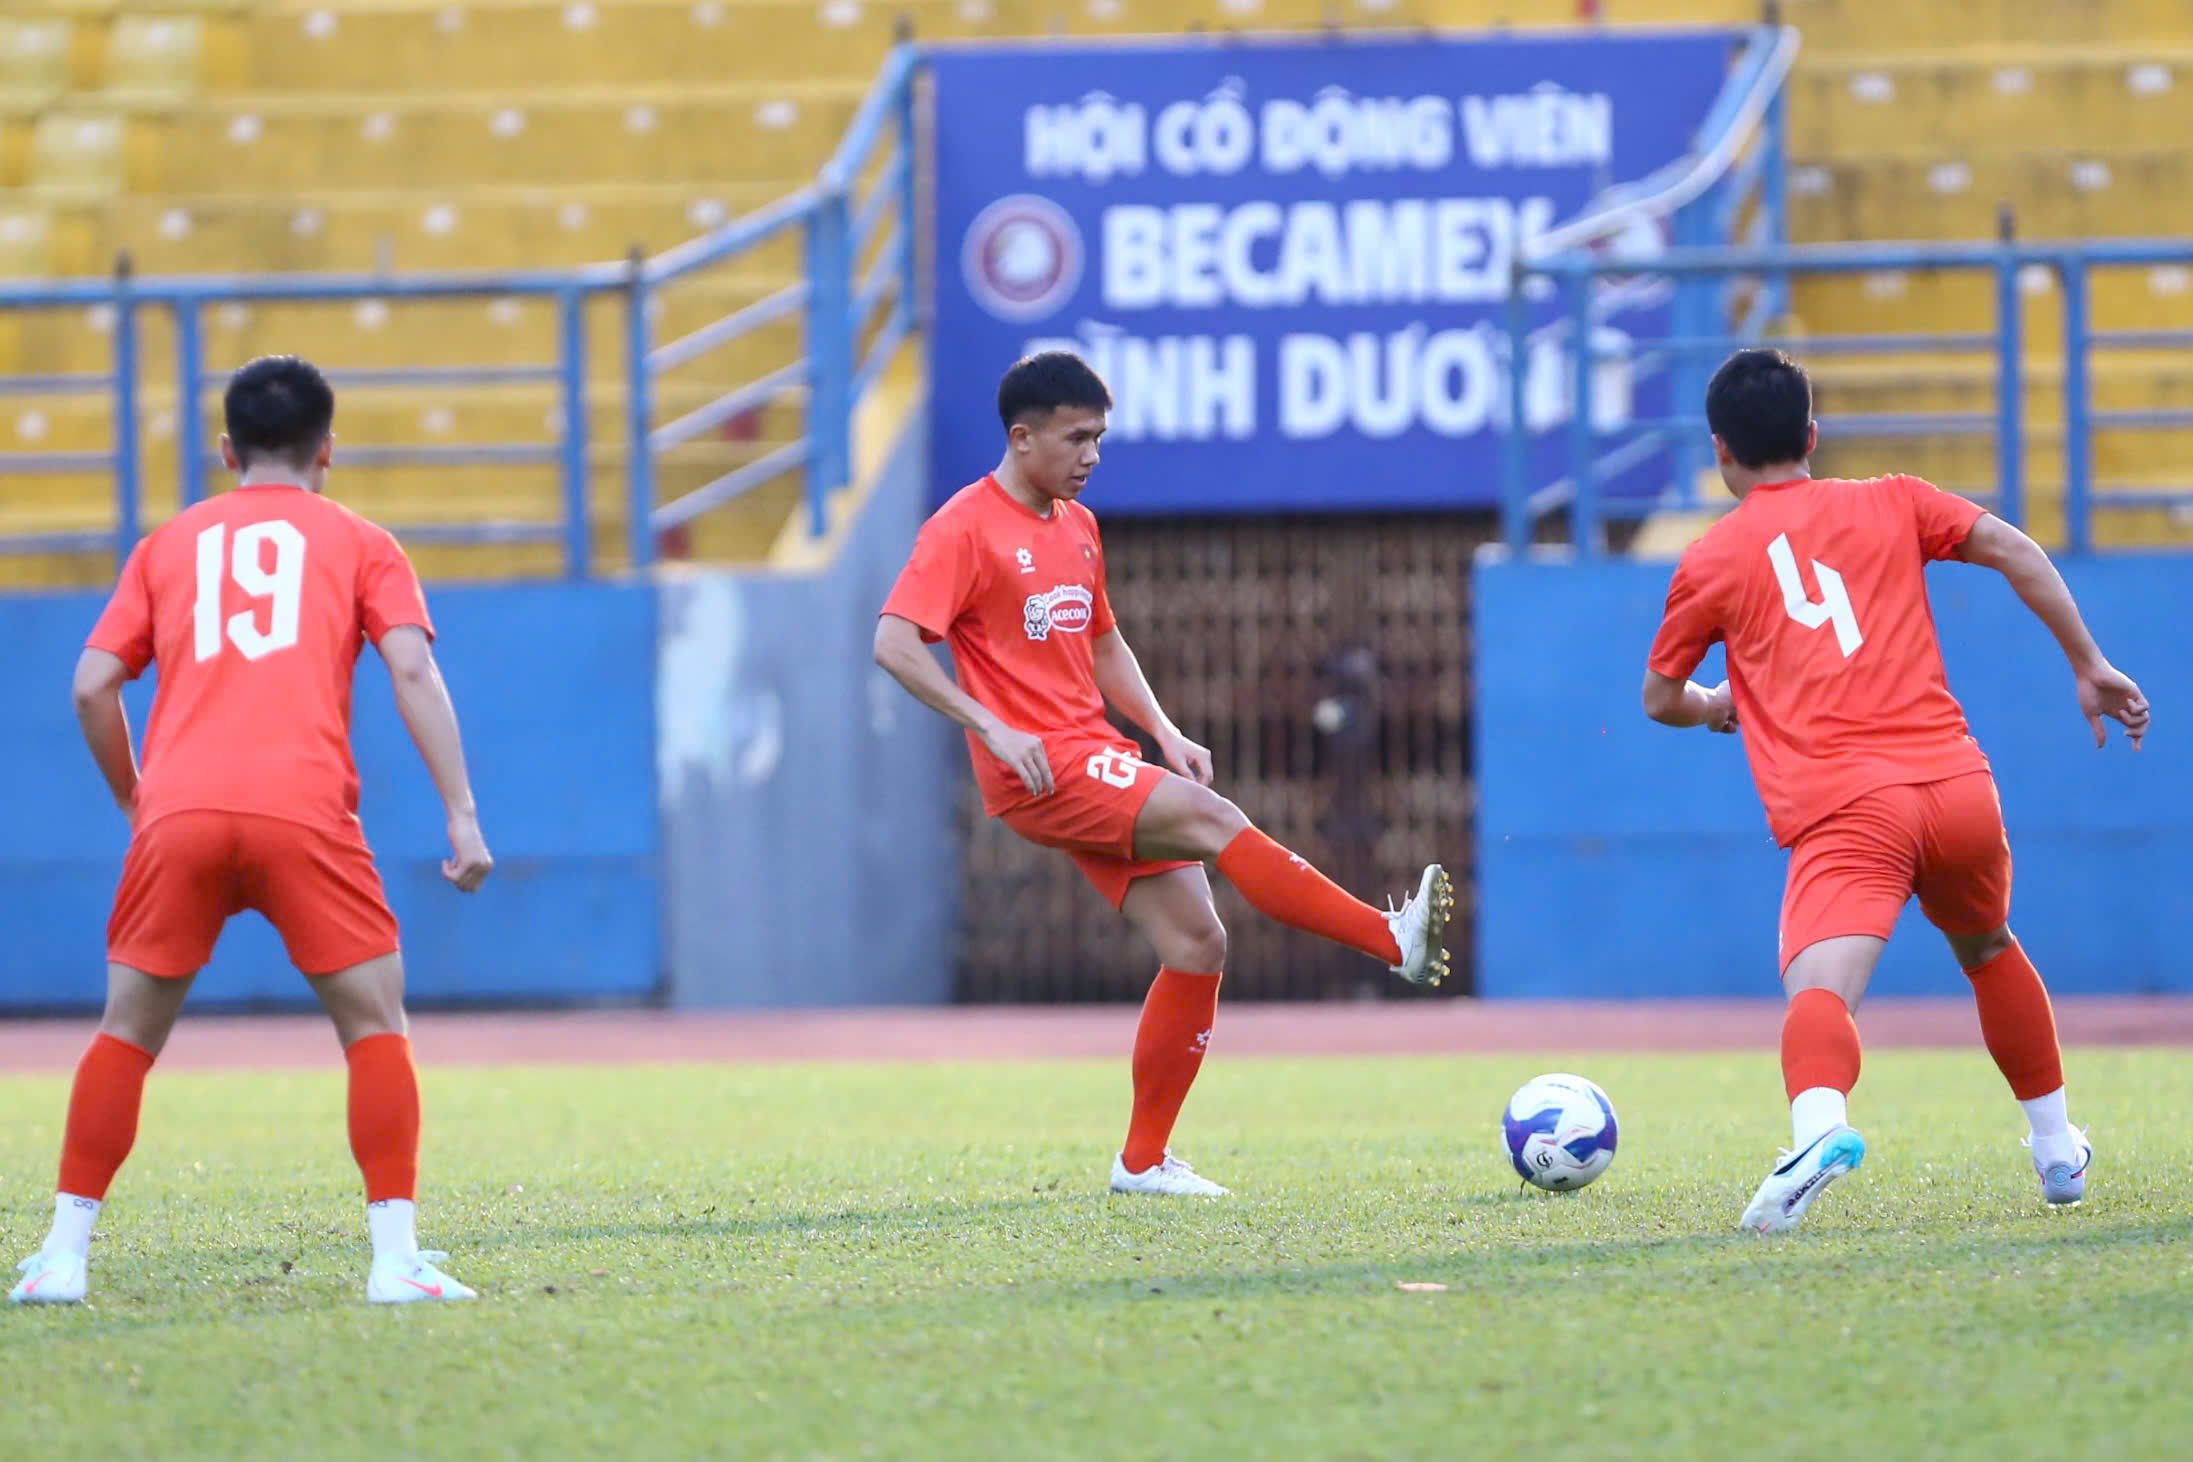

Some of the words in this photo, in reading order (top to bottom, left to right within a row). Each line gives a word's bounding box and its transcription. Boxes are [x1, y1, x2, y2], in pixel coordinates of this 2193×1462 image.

[1024, 89, 1148, 186] HỘI
[1459, 80, 1612, 169] VIÊN
[1022, 320, 1257, 440] ÌNH
[194, 520, 307, 663] 19
[1767, 531, 1864, 659] 4
[1086, 745, 1150, 790] 2
